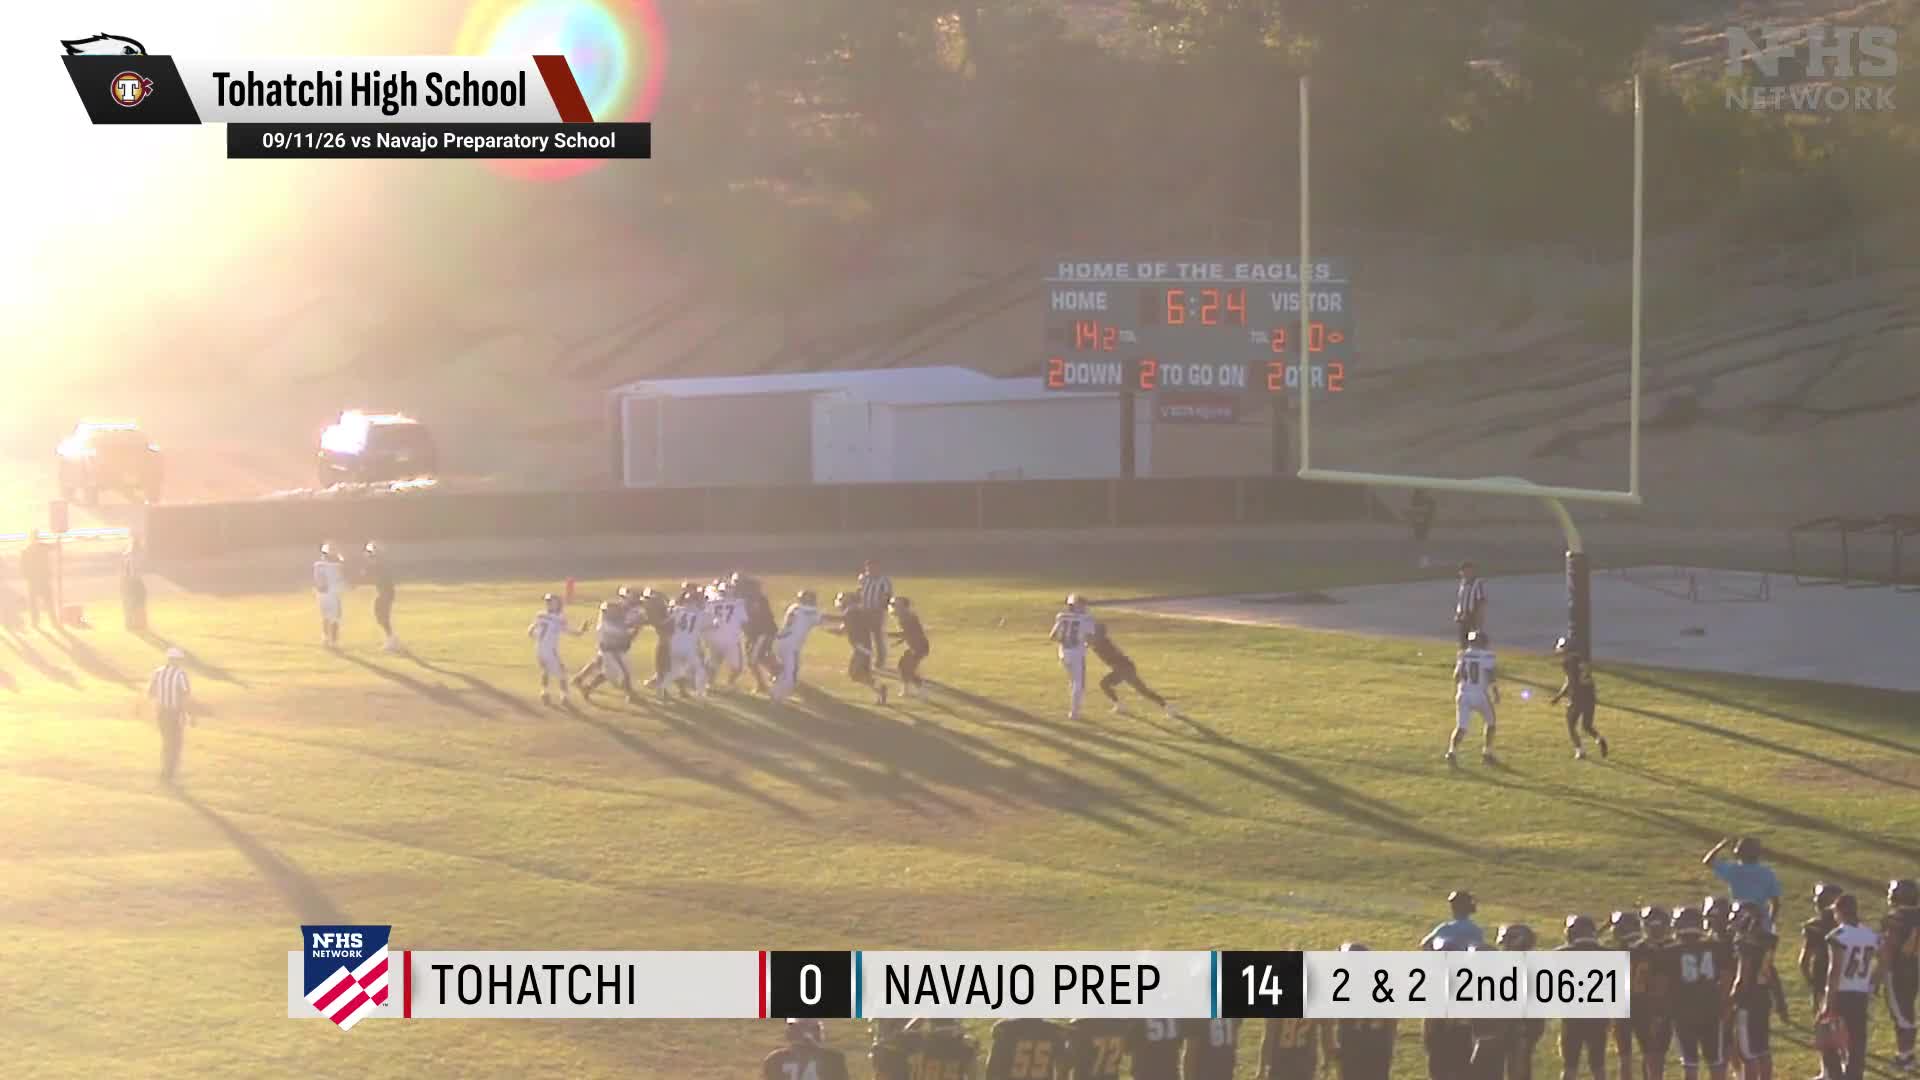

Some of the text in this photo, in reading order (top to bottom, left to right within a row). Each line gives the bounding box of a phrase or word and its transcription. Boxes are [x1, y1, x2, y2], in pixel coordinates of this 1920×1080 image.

[1058, 263, 1129, 279] HOME
[1137, 263, 1168, 279] OF
[1177, 263, 1223, 279] THE
[1051, 291, 1107, 311] HOME
[1166, 288, 1247, 326] 6:24
[1271, 292, 1343, 312] VISTOR
[1074, 320, 1098, 351] 14
[1048, 358, 1065, 387] 2
[1065, 363, 1122, 385] DOWN
[1140, 359, 1156, 389] 2
[1161, 364, 1245, 387] TO GO ON
[1266, 361, 1283, 391] 2
[1327, 362, 1344, 392] 2
